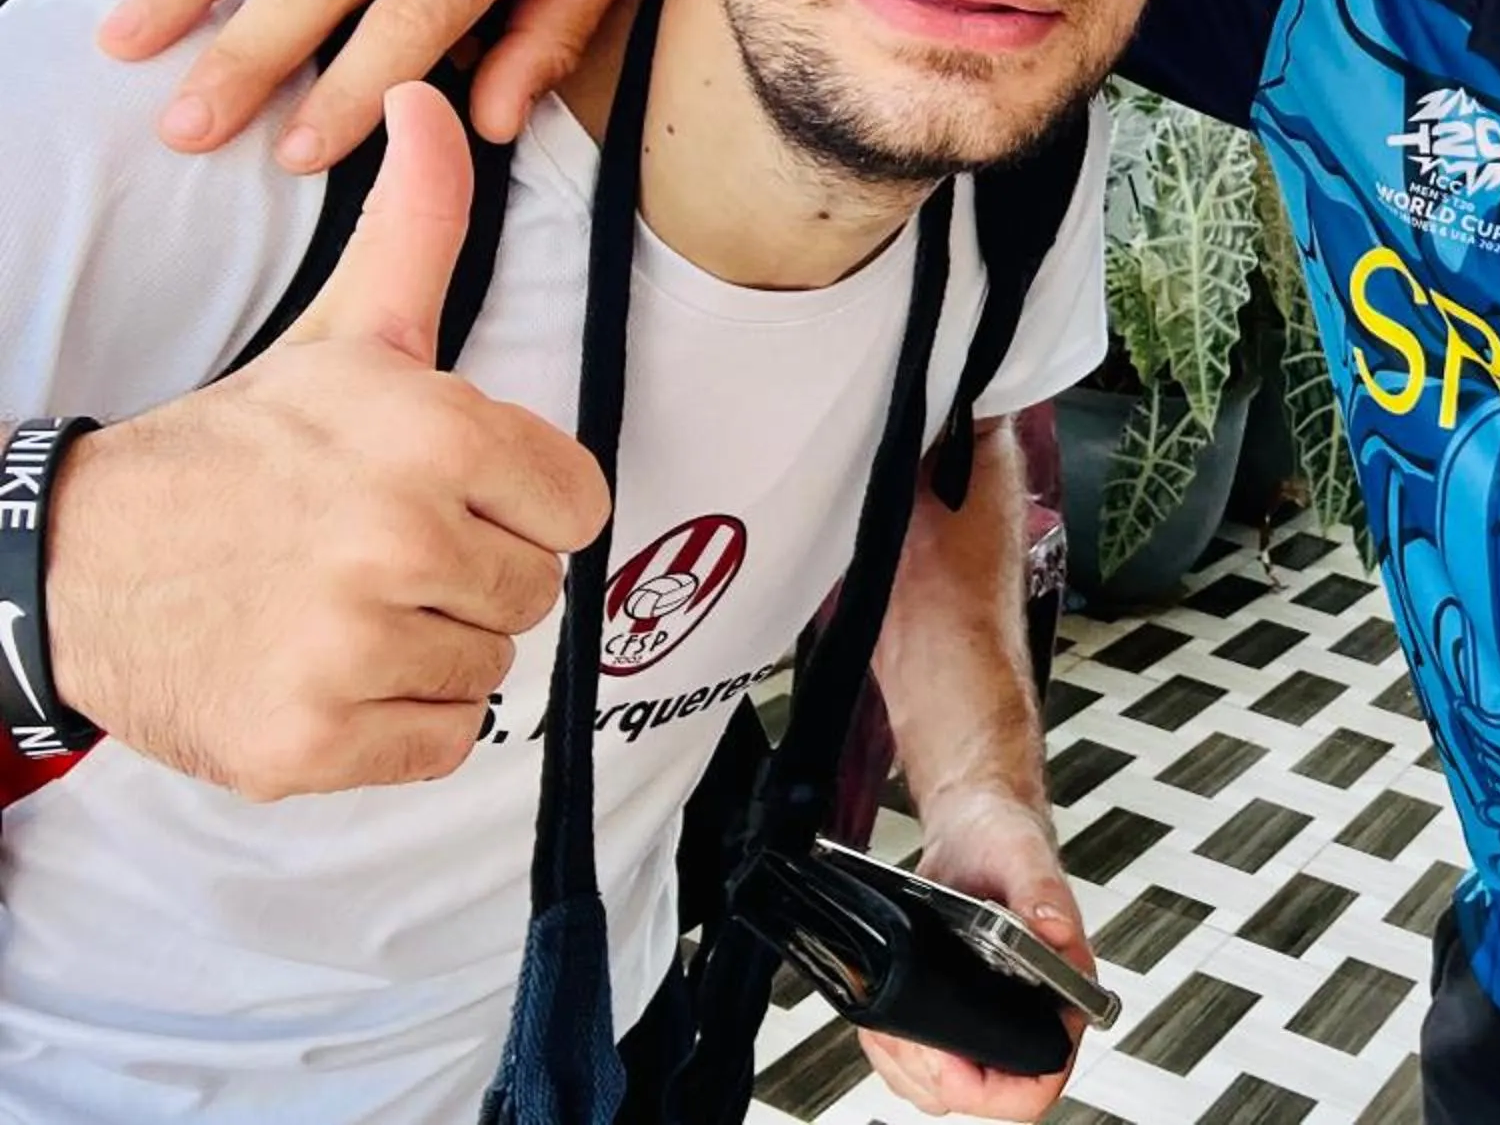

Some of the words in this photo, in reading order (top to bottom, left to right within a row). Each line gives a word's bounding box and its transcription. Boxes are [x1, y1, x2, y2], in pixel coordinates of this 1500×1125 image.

[1429, 172, 1464, 195] ICC
[1375, 181, 1456, 224] WORLD
[1451, 228, 1476, 245] USA
[0, 430, 59, 530] NIKE
[605, 630, 669, 656] CFSP
